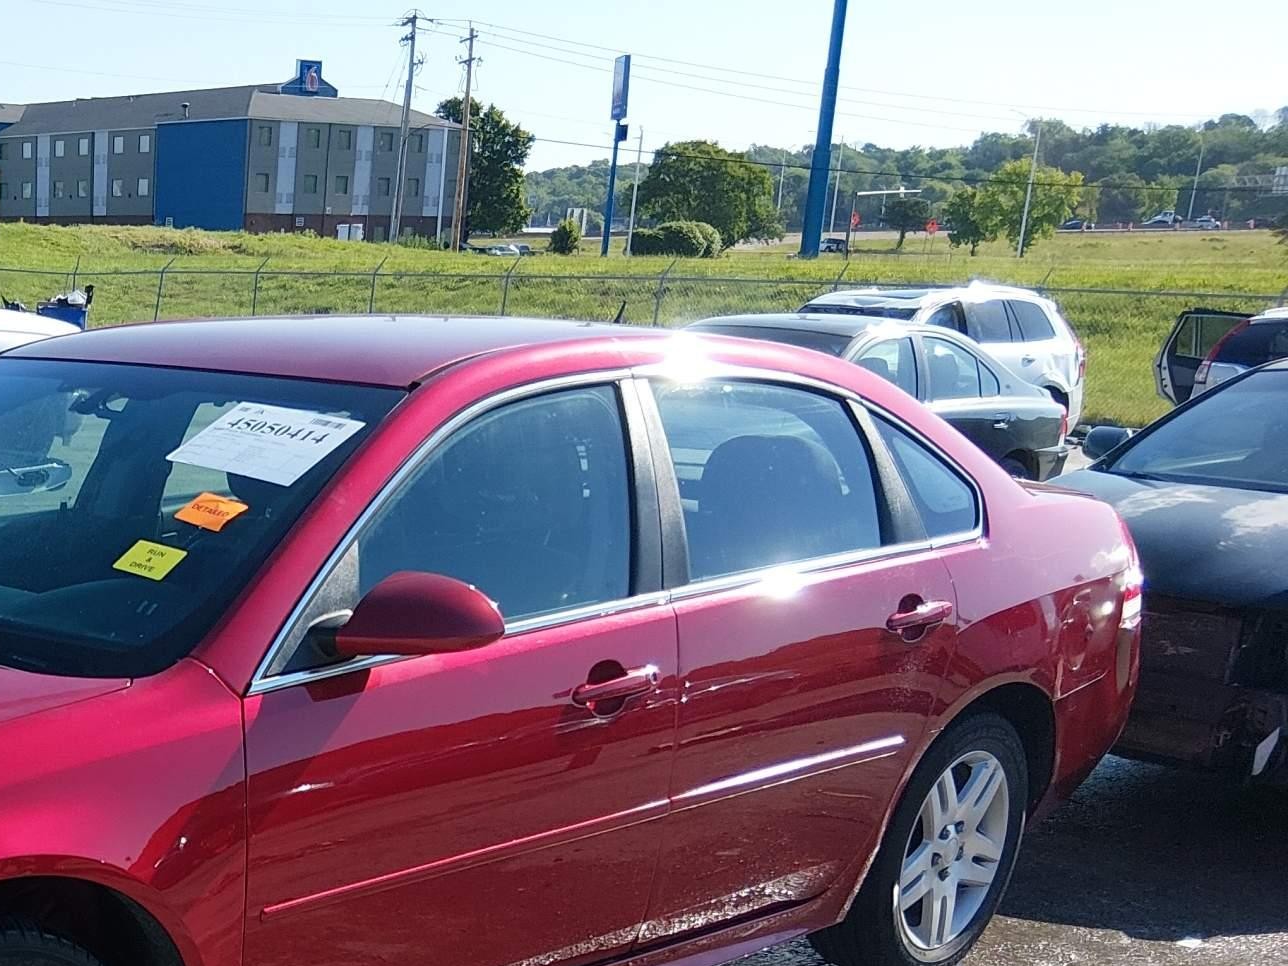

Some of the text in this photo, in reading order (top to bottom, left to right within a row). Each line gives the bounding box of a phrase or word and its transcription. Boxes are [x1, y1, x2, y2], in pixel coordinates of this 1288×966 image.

[227, 417, 330, 444] 45050414
[147, 549, 166, 558] RUN
[129, 561, 155, 572] DRIVE
